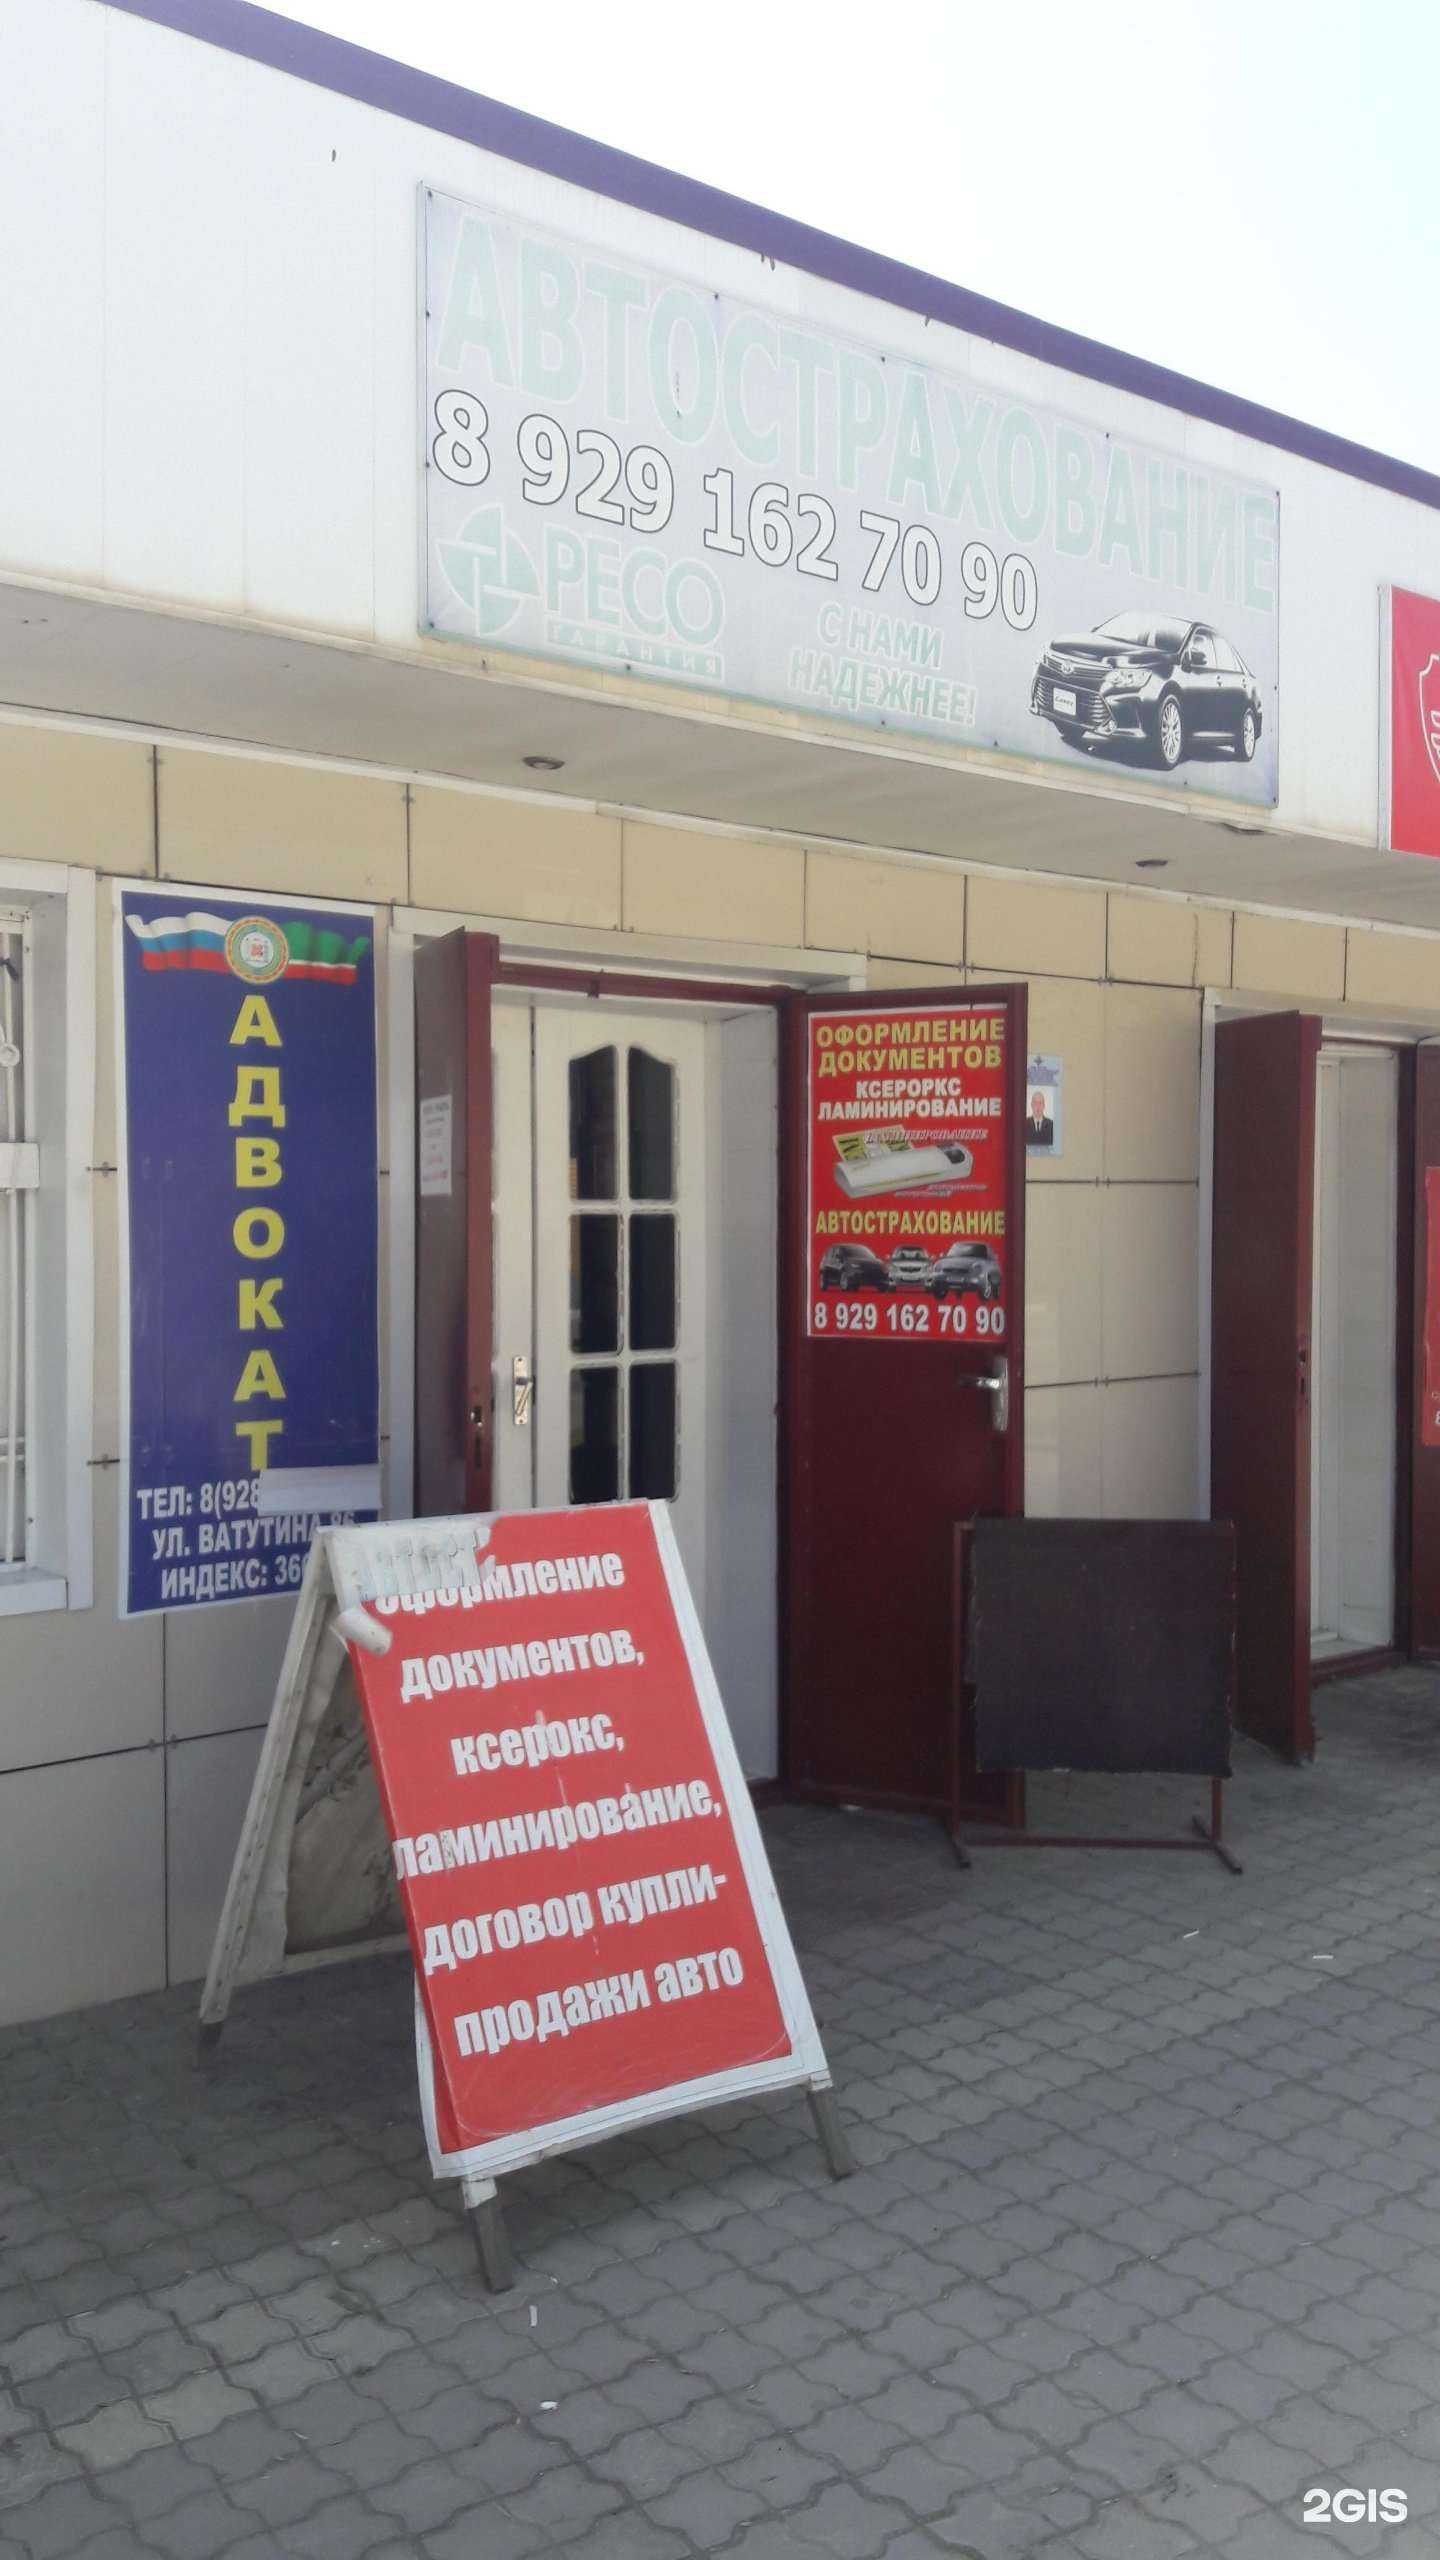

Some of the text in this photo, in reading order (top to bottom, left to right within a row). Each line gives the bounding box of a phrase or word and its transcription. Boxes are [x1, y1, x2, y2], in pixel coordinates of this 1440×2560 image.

[433, 212, 1278, 616] АВТОСТРАХОВАНИЕ
[432, 389, 1038, 632] 8 929 162 70 90
[543, 521, 727, 647] РЕСО
[550, 622, 718, 676] ГАРАНТИЯ
[816, 603, 946, 671] С НАМИ
[786, 645, 980, 728] НАДЕЖНЕЕ!
[815, 1017, 1005, 1048] ОФОРМЛЕНИЕ
[818, 1045, 1002, 1078] ДОКУМЕНТОВ
[817, 1097, 1002, 1121] ЛАМИНИРОВАНИЕ
[855, 1077, 962, 1100] КСЕРОРКС
[228, 994, 287, 1472] АДВОКАТ
[815, 1210, 1005, 1235] АВТОСТРАХОВАНИЕ
[814, 1302, 1006, 1334] 8 929 162 70 90
[136, 1486, 193, 1521] ТЕЛ:
[152, 1525, 190, 1560] УЛ.
[161, 1557, 268, 1601] ИНДЕКС:
[400, 1628, 646, 1704] документов,
[450, 1711, 625, 1777] ксерокс,
[392, 1778, 723, 1880] ламинирование,
[422, 1863, 728, 1976] договор купли-
[453, 1946, 745, 2057] продажи авто
